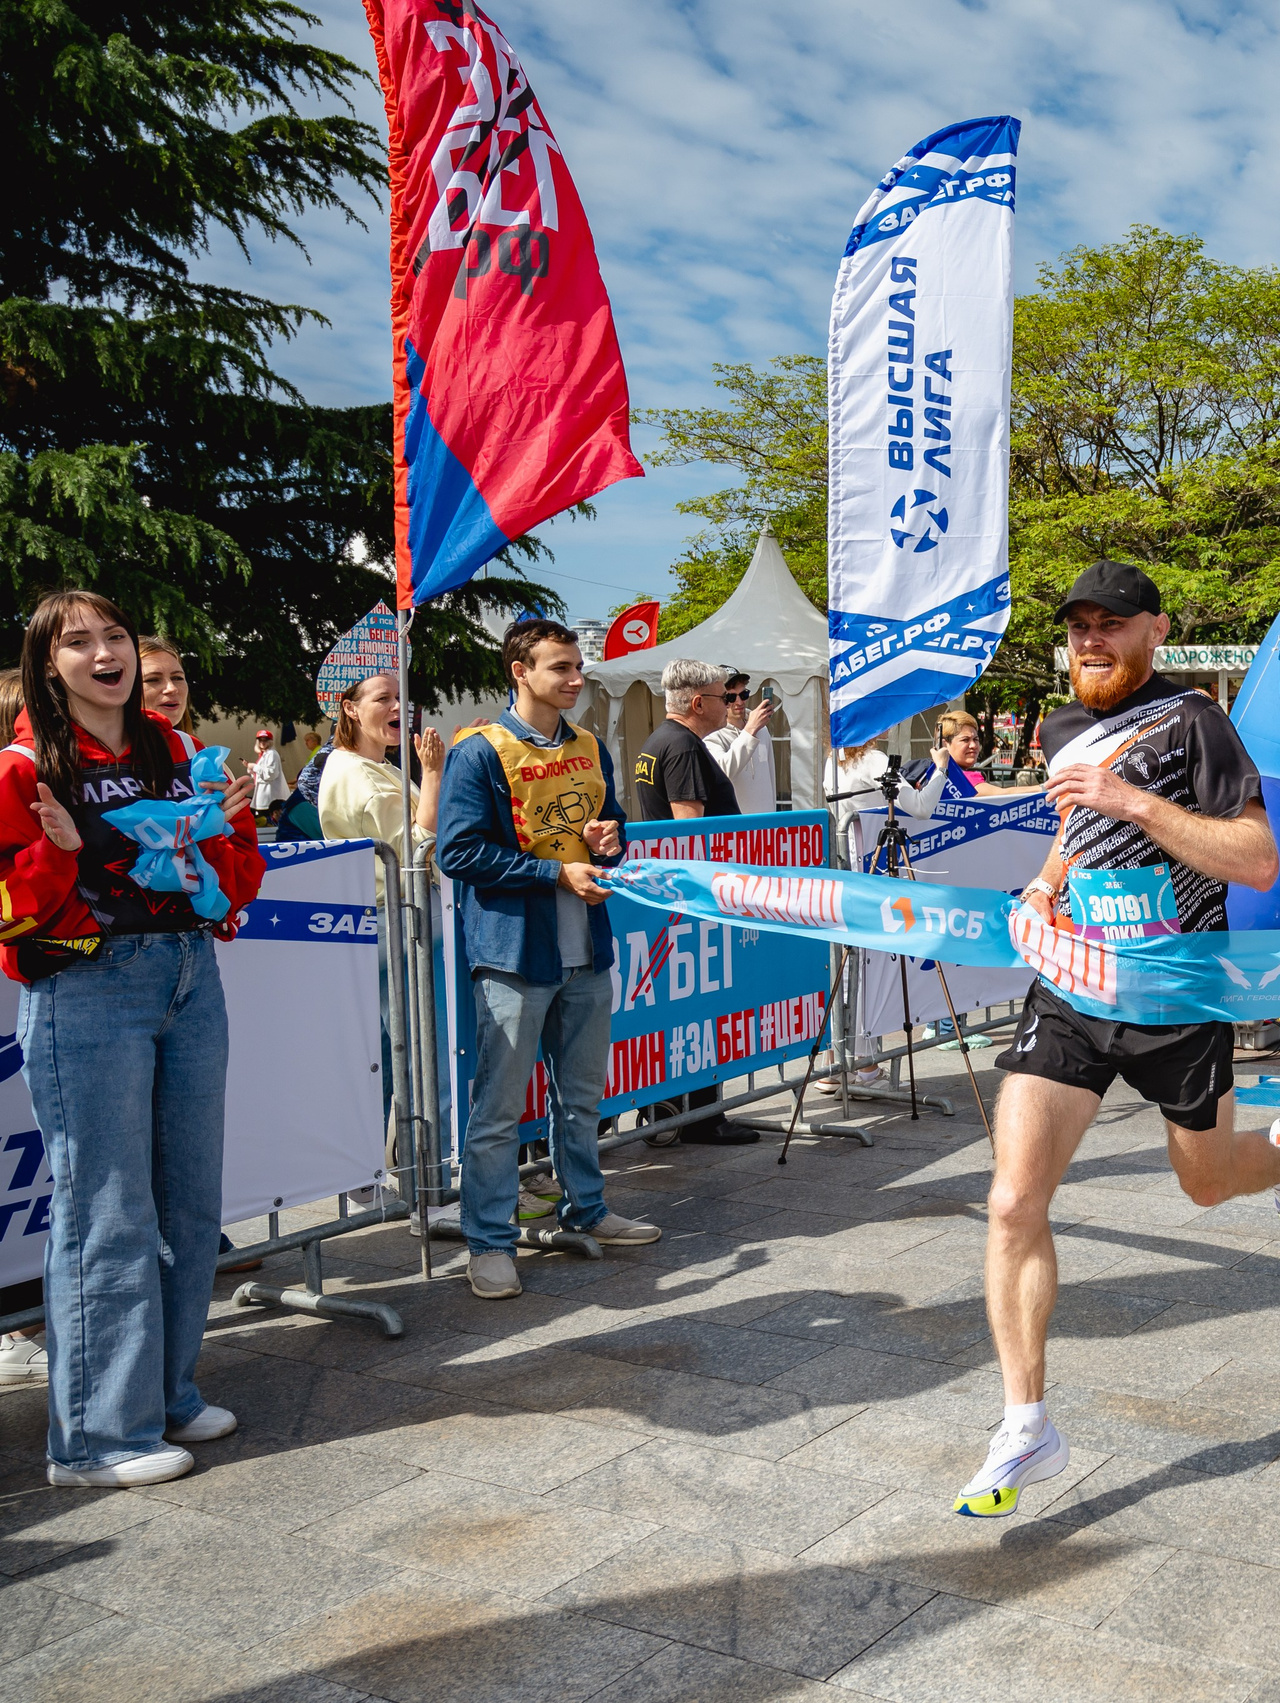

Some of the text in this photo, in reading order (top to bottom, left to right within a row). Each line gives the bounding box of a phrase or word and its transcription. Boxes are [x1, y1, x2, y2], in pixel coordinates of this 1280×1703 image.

[888, 257, 918, 471] ВЫСШАЯ
[924, 349, 953, 478] ЛИГА
[353, 627, 384, 640] #ЗАБЕГ
[358, 641, 397, 655] #МОМЕНТ
[1165, 650, 1255, 664] МОРОЖЕНО
[521, 756, 594, 782] ВОЛОНТЕР
[908, 826, 966, 857] БЕГ.РФ
[711, 872, 848, 932] ФИНИШ
[1088, 893, 1152, 922] 30191
[922, 906, 985, 940] ПСБ
[1219, 994, 1244, 1003] ЛИГА
[669, 1009, 757, 1079] #ЗАБЕГ
[760, 991, 826, 1052] #ЦЕЛЬ
